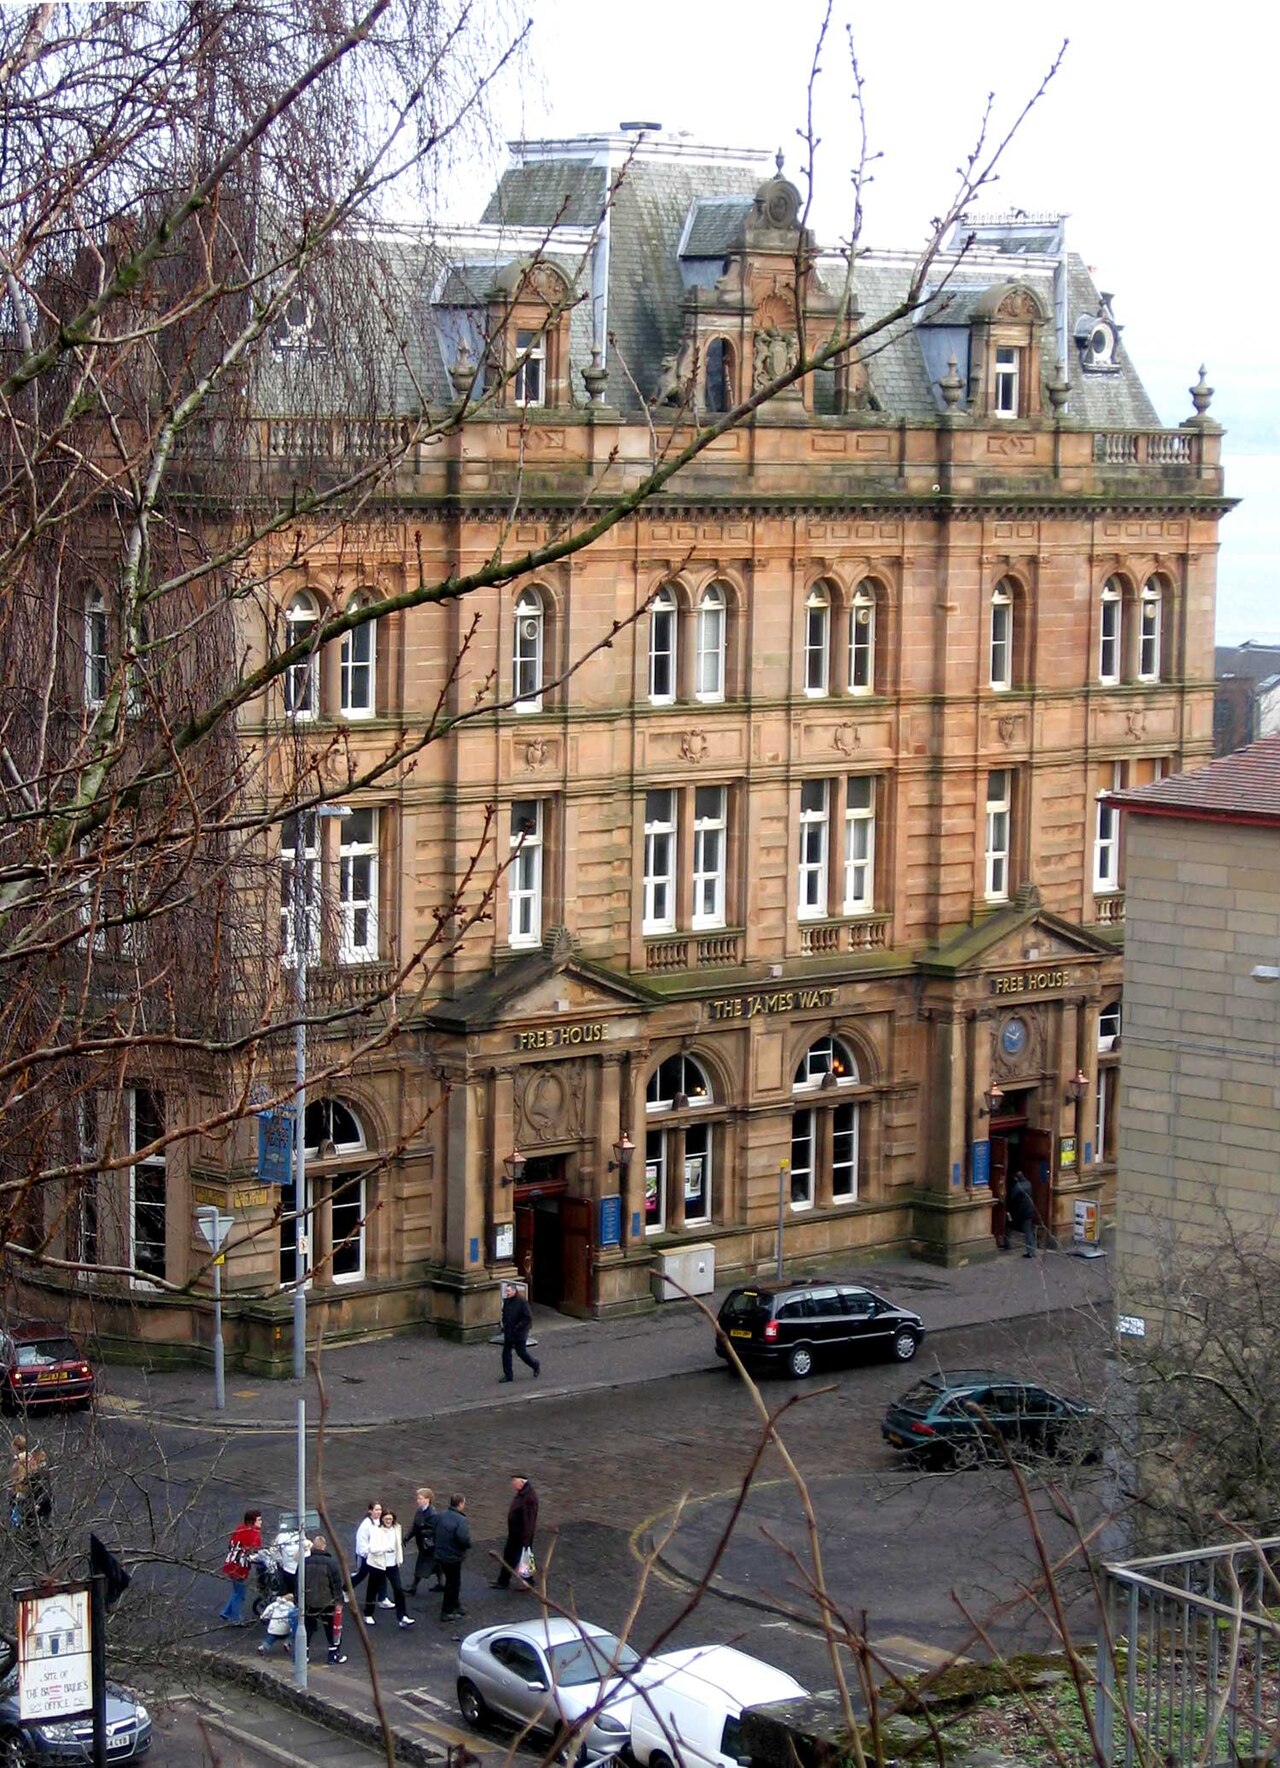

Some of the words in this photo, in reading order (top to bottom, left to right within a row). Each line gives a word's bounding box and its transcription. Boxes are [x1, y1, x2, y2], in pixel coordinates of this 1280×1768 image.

[995, 976, 1024, 994] FREE
[1028, 971, 1069, 990] HOUSE
[713, 998, 743, 1019] THE
[747, 993, 794, 1018] JAMES
[799, 988, 839, 1009] WATT
[519, 1030, 554, 1050] FREE
[560, 1023, 609, 1045] HOUSE
[43, 1671, 57, 1682] SITE
